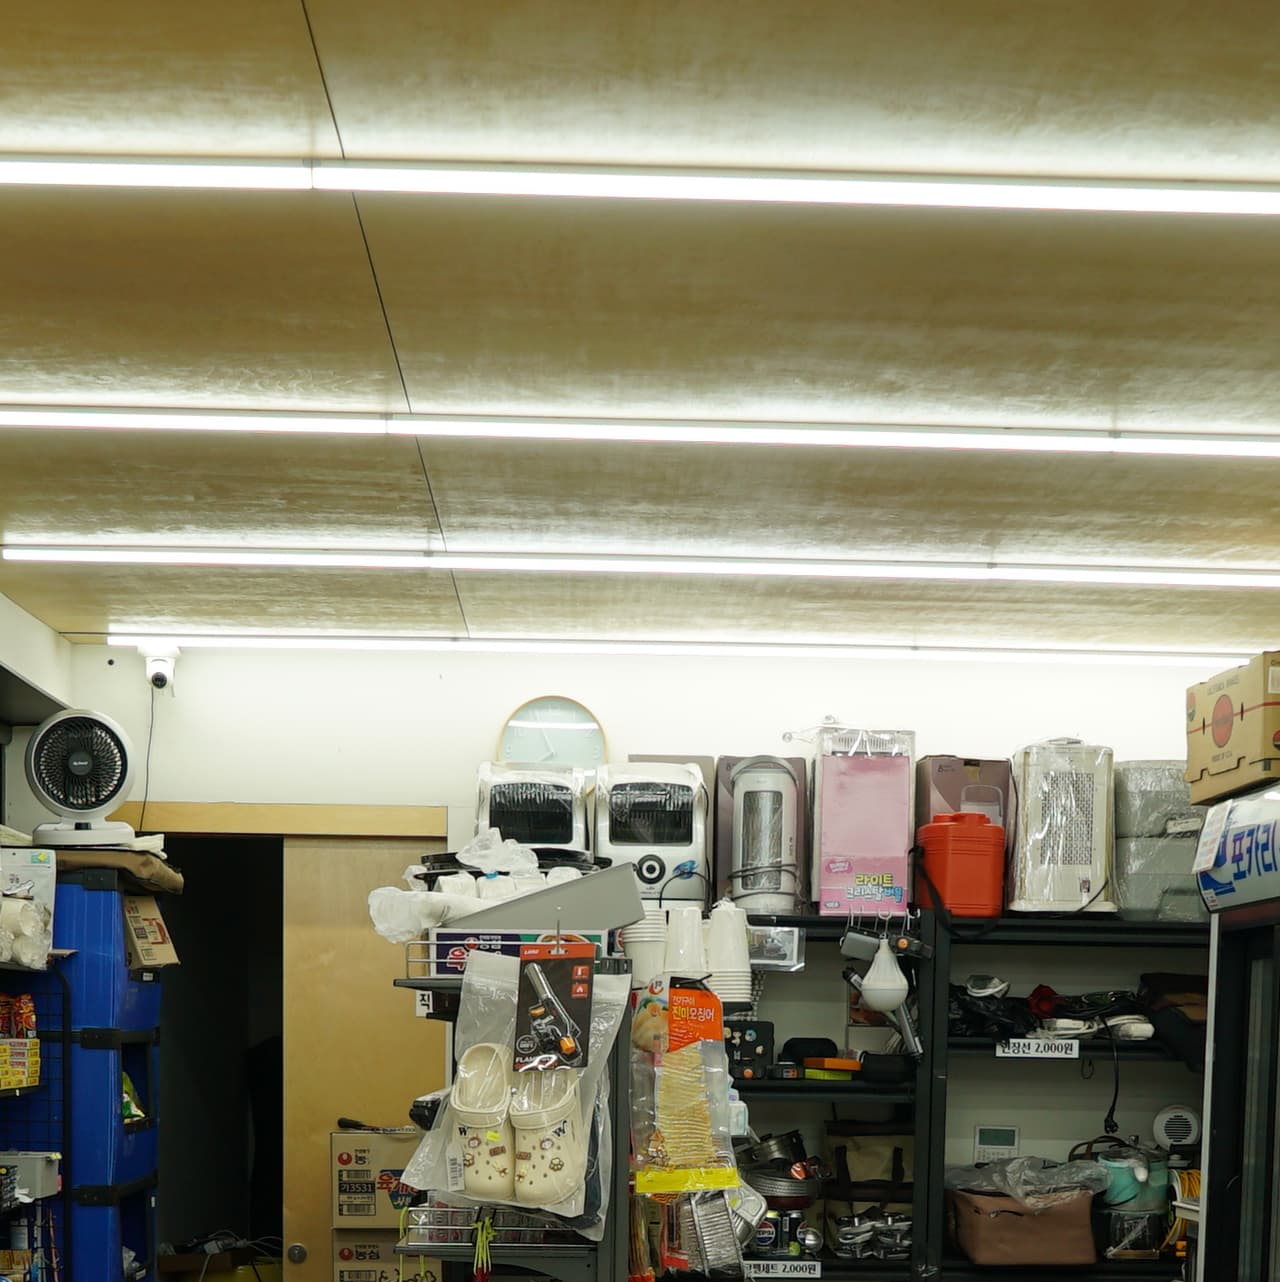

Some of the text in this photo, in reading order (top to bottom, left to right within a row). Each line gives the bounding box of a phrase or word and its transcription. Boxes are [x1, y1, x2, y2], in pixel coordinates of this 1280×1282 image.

[1230, 816, 1279, 882] 포카리
[855, 874, 893, 886] 라이트
[672, 1007, 715, 1022] 진미오징어
